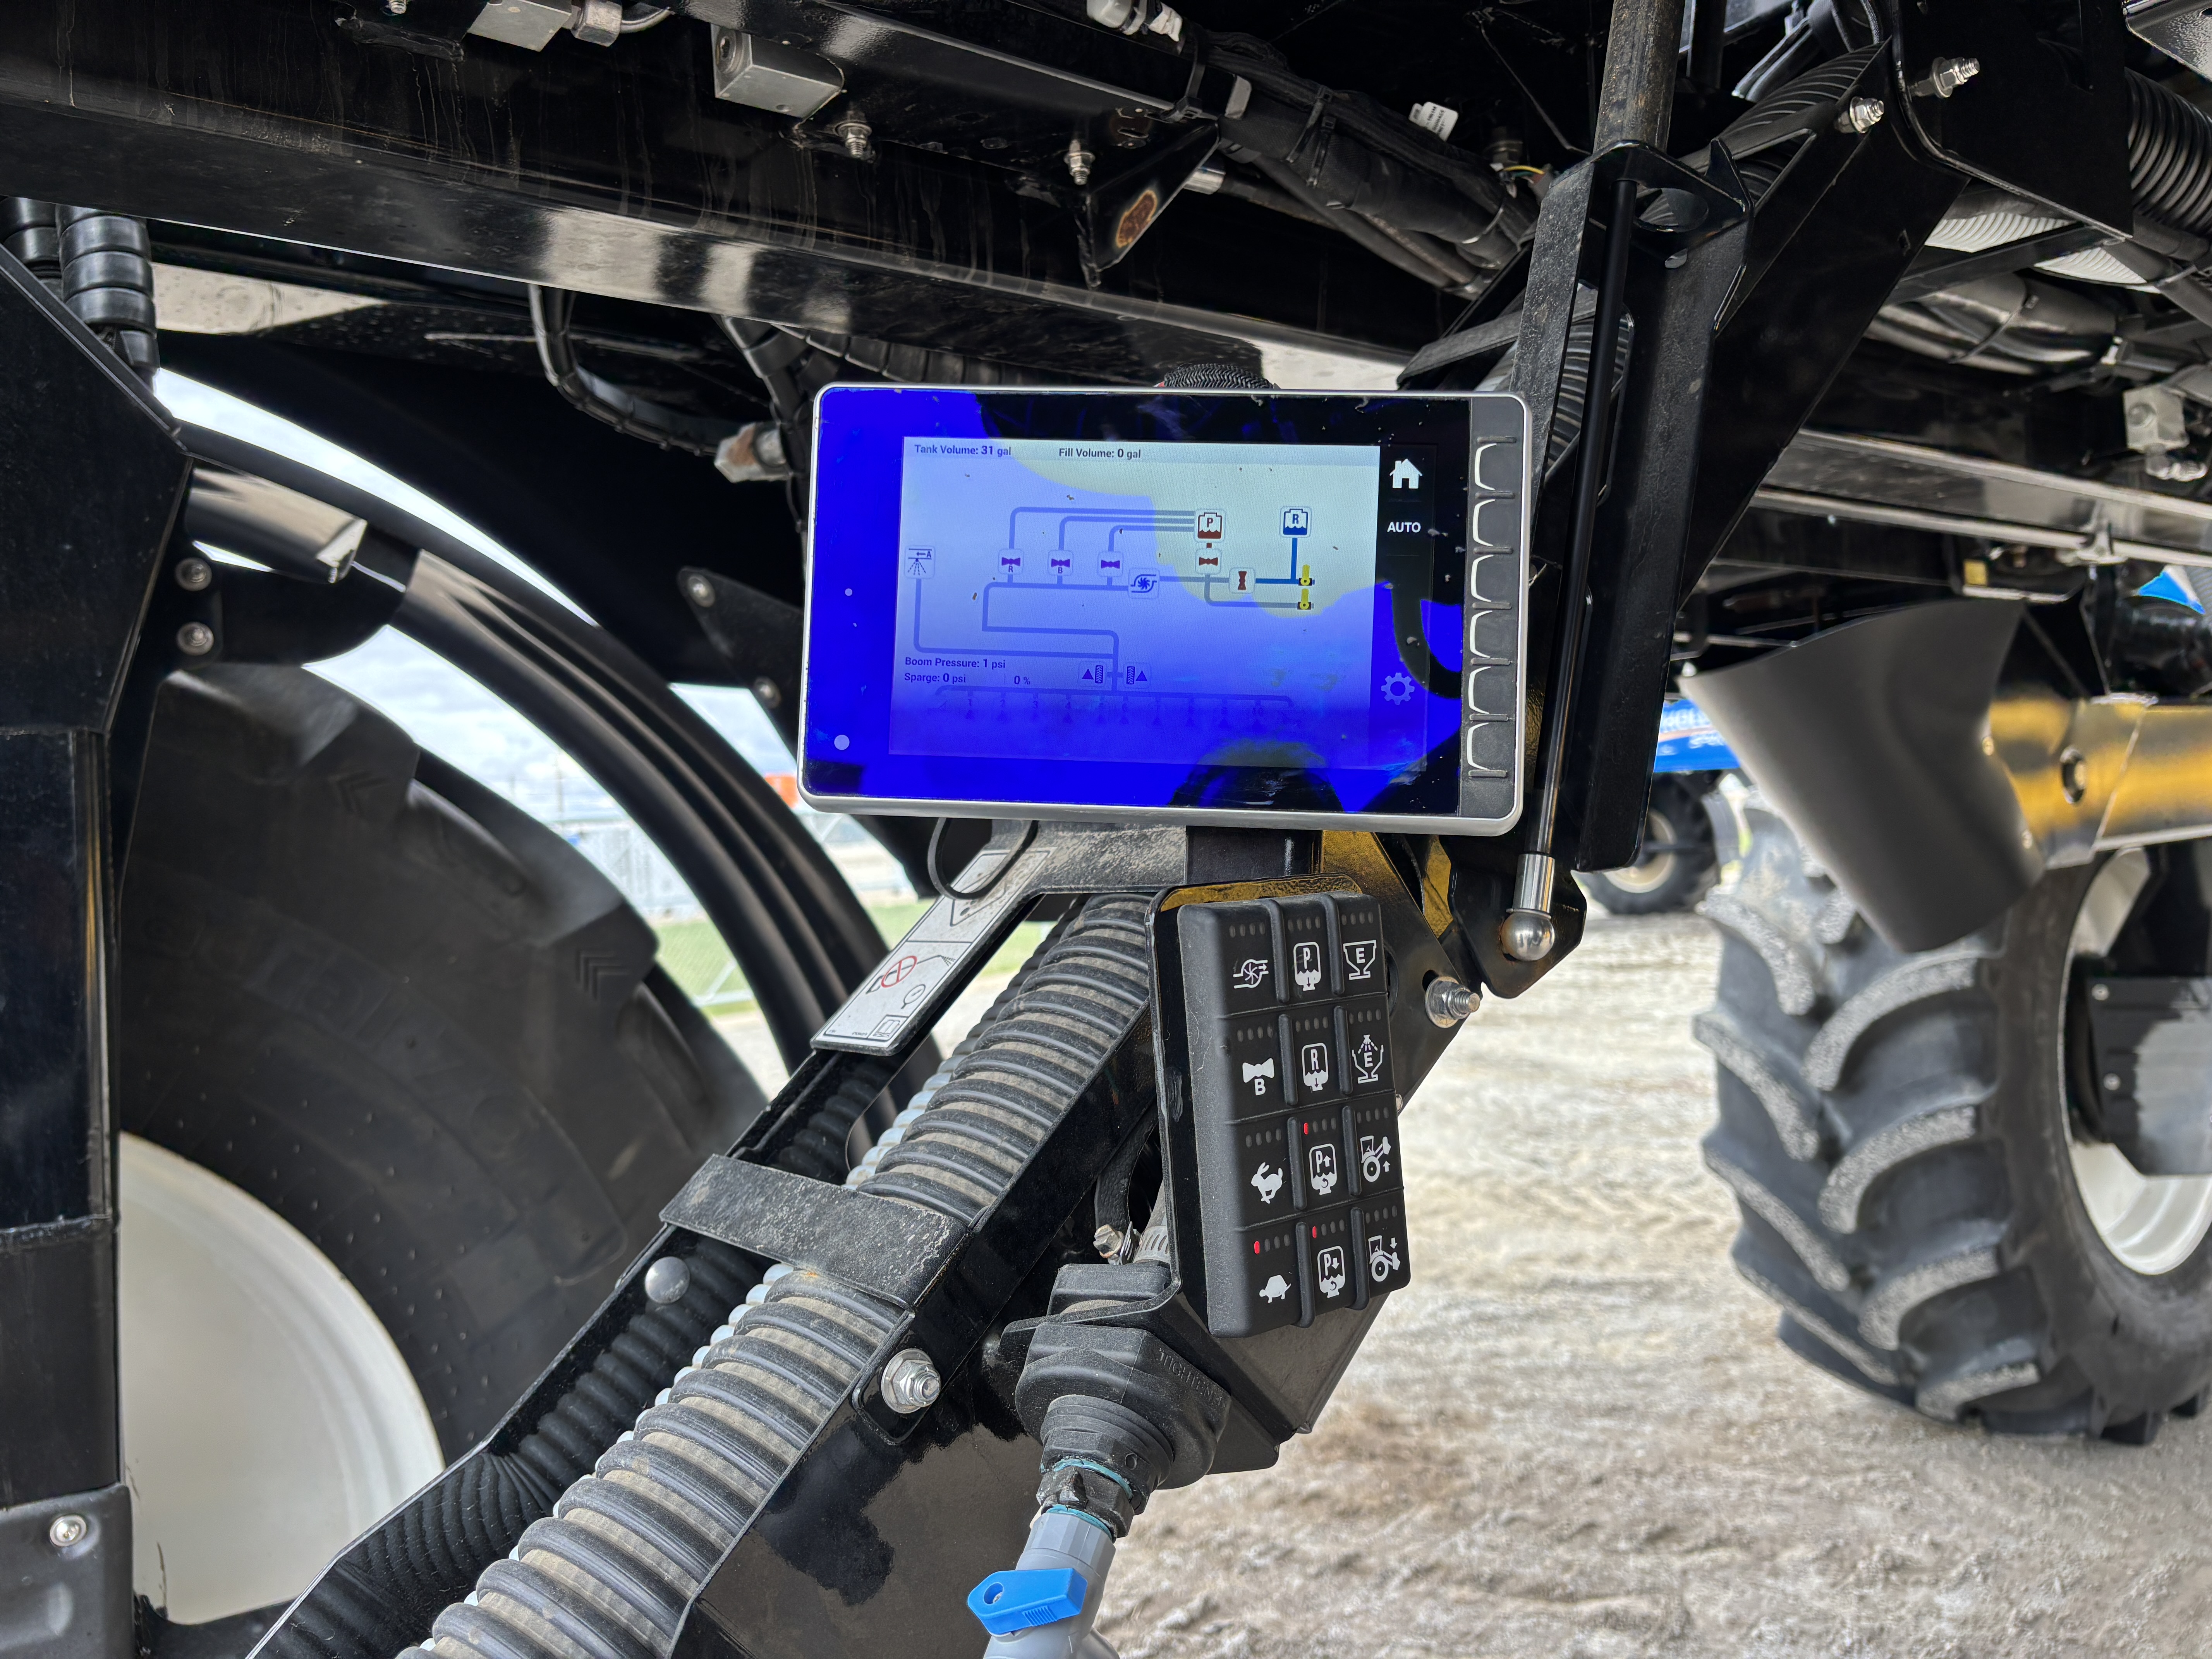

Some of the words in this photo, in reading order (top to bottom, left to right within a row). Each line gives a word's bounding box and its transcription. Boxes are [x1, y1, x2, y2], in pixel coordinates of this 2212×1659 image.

[914, 444, 938, 454] Tank
[939, 445, 979, 455] Volume:
[981, 446, 994, 455] 31
[997, 447, 1012, 457] gal
[1059, 448, 1073, 457] Fill
[1075, 448, 1115, 458] Volume:
[1117, 448, 1124, 458] 0
[1126, 450, 1141, 460] gal
[1206, 517, 1214, 527] P
[1292, 514, 1299, 524] R
[1387, 522, 1421, 533] AUTO
[905, 657, 932, 666] Boom
[935, 658, 980, 668] Pressure:
[983, 659, 988, 668] 1
[991, 659, 1006, 670] psi
[904, 673, 940, 684] Sparge:
[943, 673, 950, 682] 0
[952, 674, 966, 684] psi
[1014, 675, 1020, 684] 0
[1023, 677, 1030, 685] %
[1303, 947, 1311, 969] P
[1355, 947, 1366, 964] E
[1310, 1049, 1319, 1071] R
[1364, 1052, 1373, 1068] E
[1254, 1078, 1266, 1096] B
[1315, 1150, 1323, 1173] P
[1323, 1253, 1331, 1276] P
